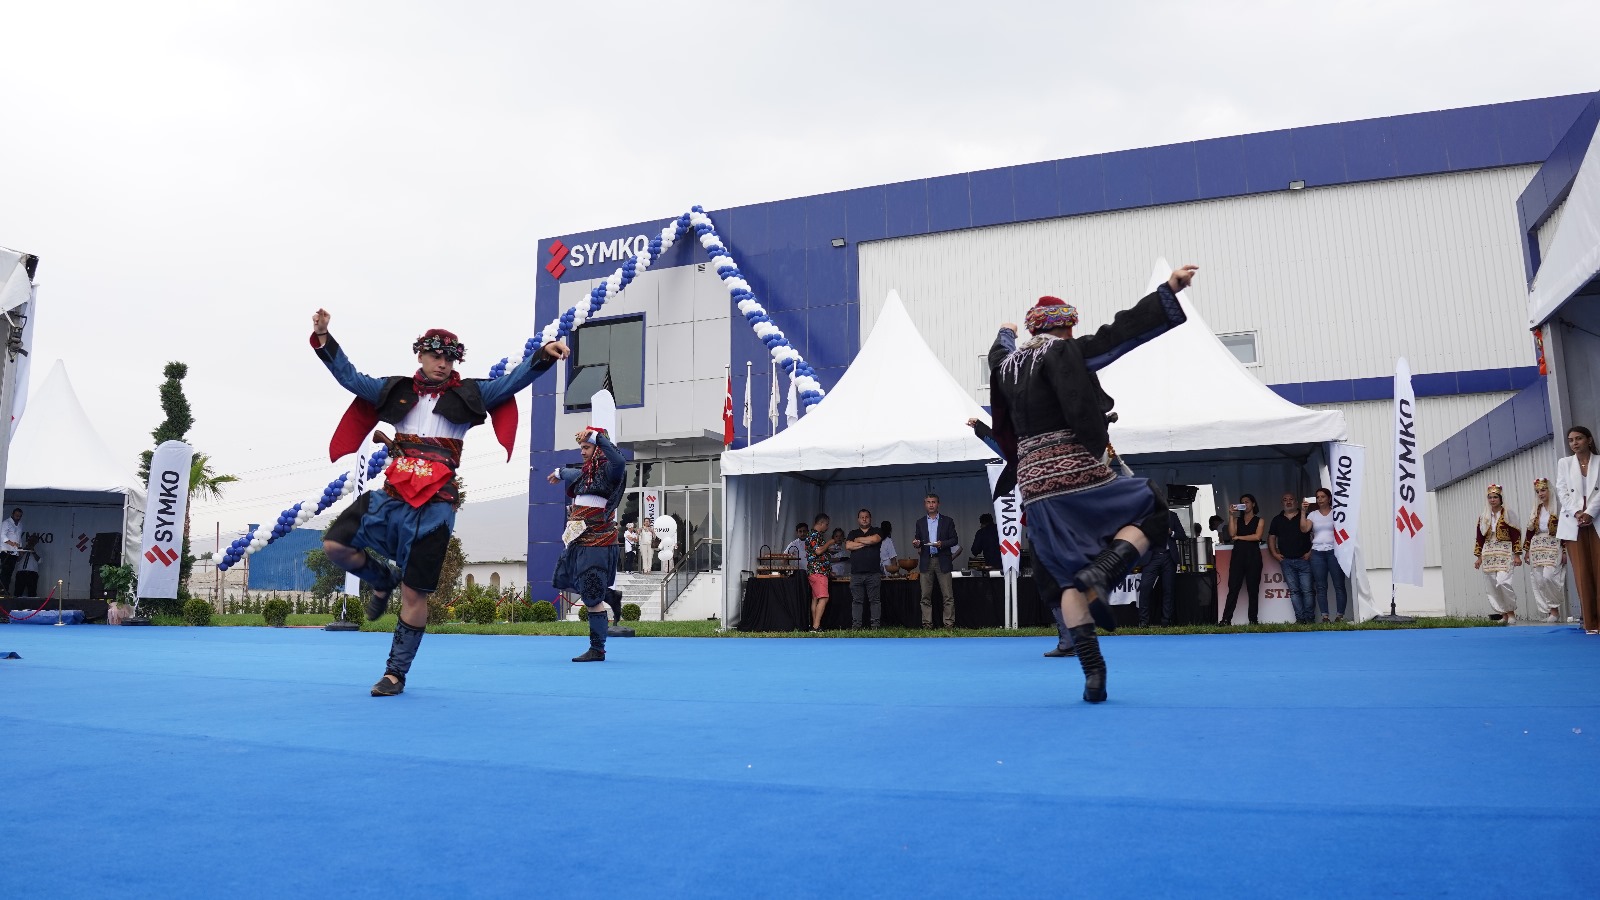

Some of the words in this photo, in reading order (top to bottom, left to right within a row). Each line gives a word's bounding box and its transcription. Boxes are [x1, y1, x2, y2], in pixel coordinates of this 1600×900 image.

[569, 235, 649, 267] SYMKO
[1399, 399, 1416, 503] SYMKO
[358, 455, 366, 496] MKO
[1332, 455, 1352, 523] SYMKO
[154, 470, 180, 542] SYMKO
[1000, 489, 1017, 537] SYM
[1264, 573, 1287, 584] LO
